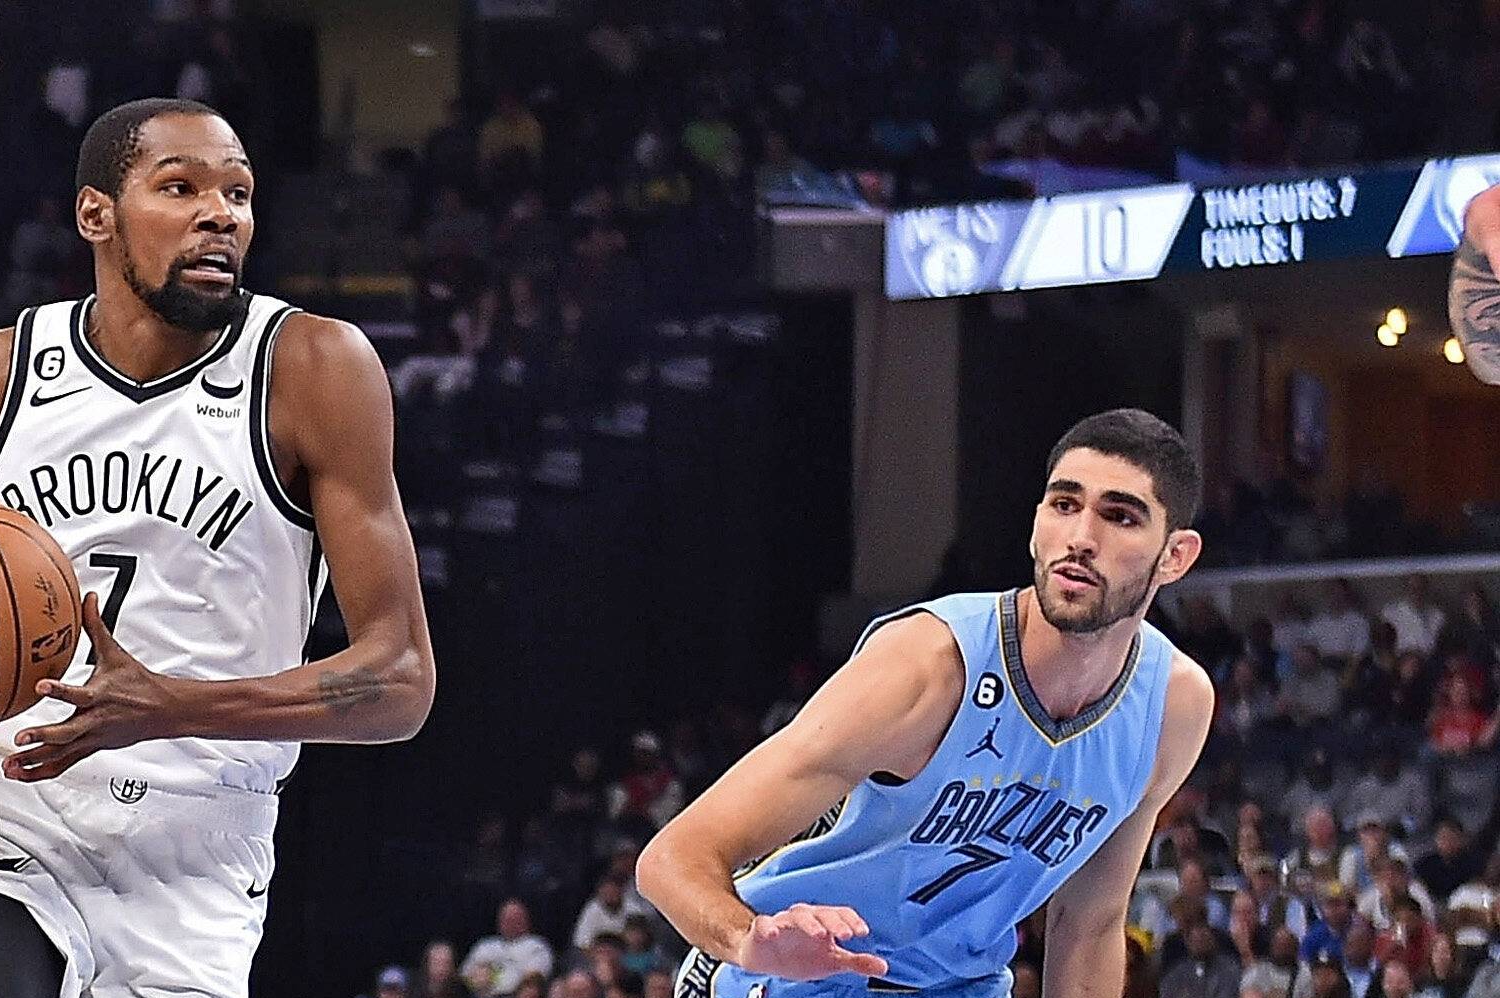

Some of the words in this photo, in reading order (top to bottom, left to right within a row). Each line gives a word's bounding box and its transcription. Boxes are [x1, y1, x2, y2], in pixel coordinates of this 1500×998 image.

[1202, 179, 1336, 228] TIMEOUTS:
[39, 348, 63, 379] 6
[196, 403, 241, 419] Webull
[1, 450, 254, 552] BROOKLYN
[85, 553, 138, 666] 7
[977, 676, 998, 706] 6
[906, 843, 1011, 906] 7
